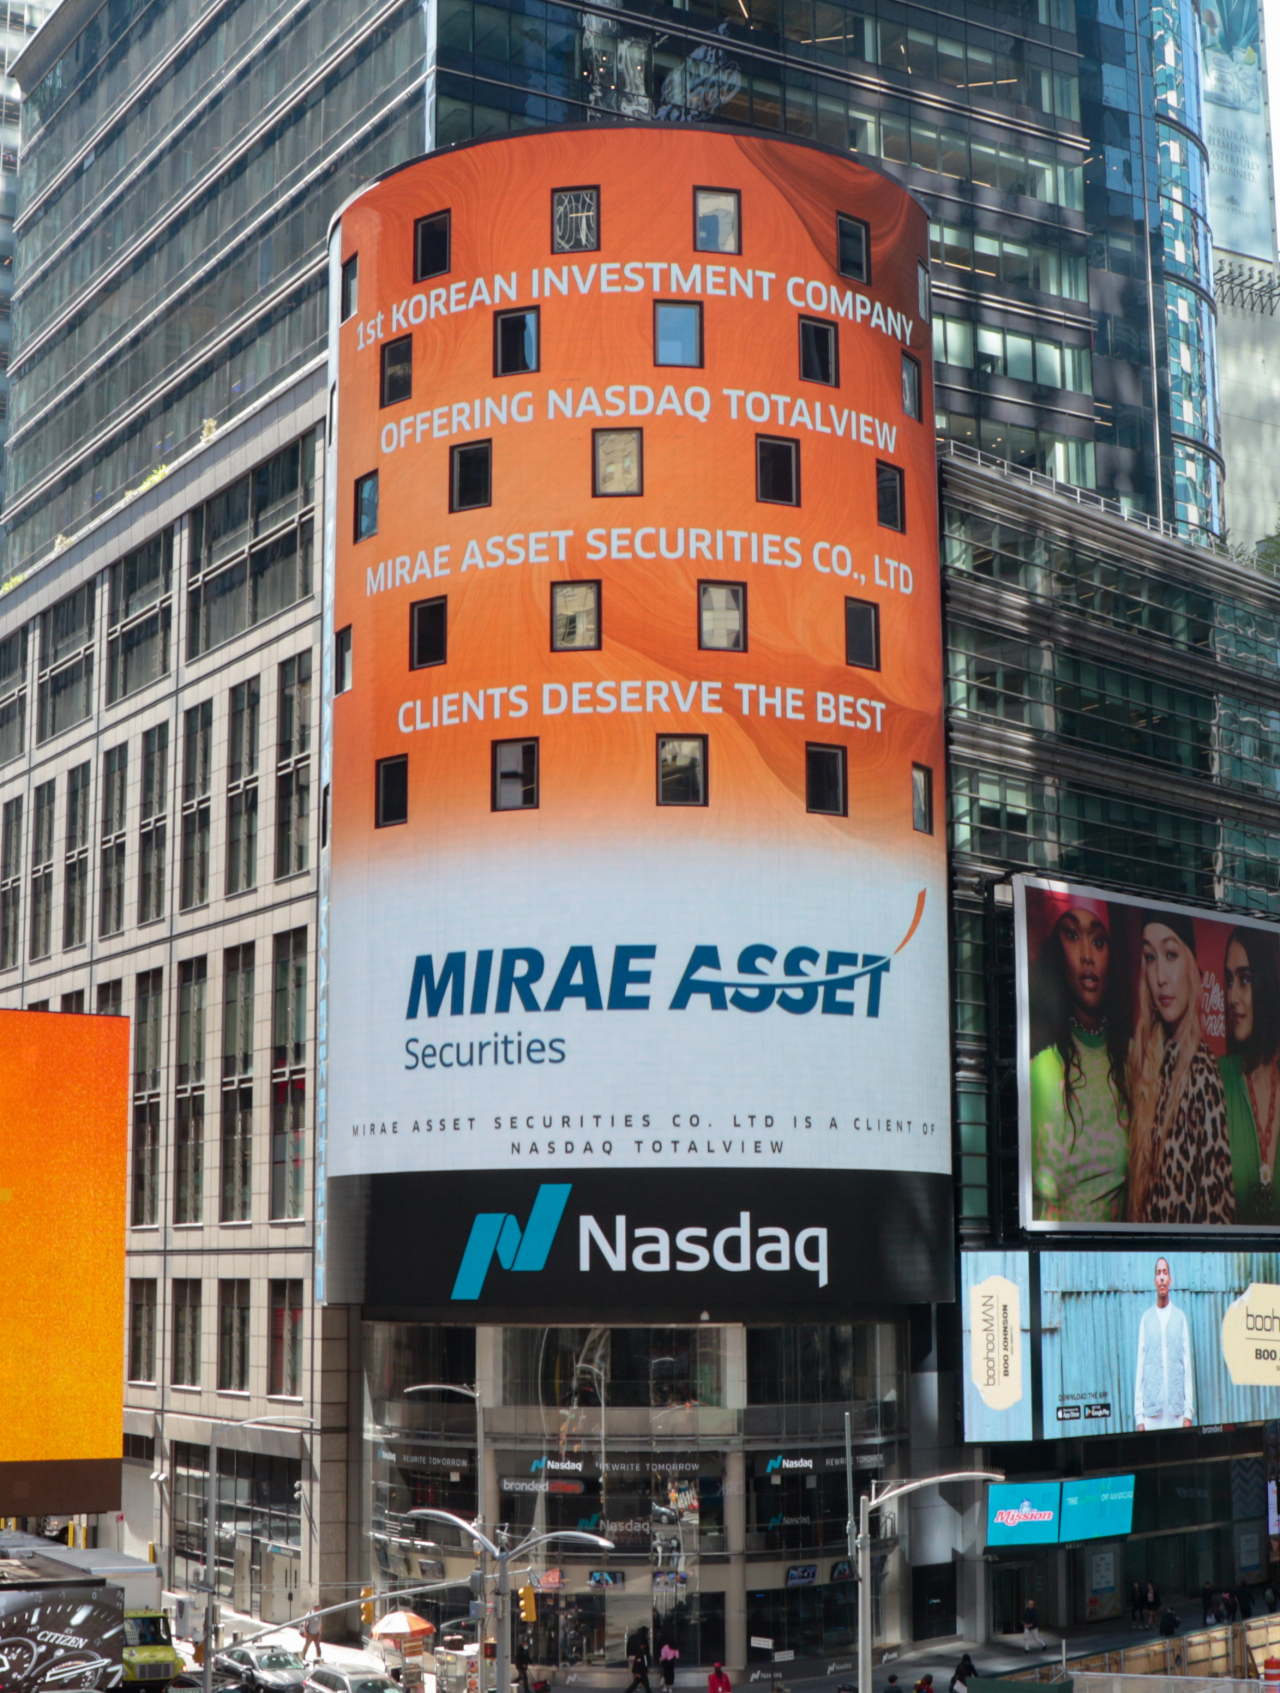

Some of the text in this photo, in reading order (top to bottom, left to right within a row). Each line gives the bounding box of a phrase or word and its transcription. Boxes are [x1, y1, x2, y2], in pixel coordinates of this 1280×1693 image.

[1208, 124, 1248, 144] NATURAL
[1208, 136, 1252, 156] ELEMENTS
[1209, 150, 1260, 172] ASTERFULLY
[356, 261, 914, 352] 1st KOREAN INVESTMENT COMPANY
[380, 384, 897, 454] OFFERING NASDAQ TOTALVIEW
[365, 527, 914, 598] MIRAE ASSET SECURITIES CO., LTD
[397, 680, 886, 734] CLIENTS DESERVE THE BEST
[405, 943, 892, 1021] MIRAE ASSET
[404, 1031, 566, 1071] Securities
[352, 1113, 935, 1137] MIRAE ASSET SECURITIES CO. LTD IS A CLIENT OF
[511, 1139, 785, 1155] NASDAQ TOTALVIEW
[579, 1211, 829, 1288] Nasdaq
[981, 1295, 995, 1387] boohooMAN
[1255, 1348, 1277, 1361] BOO
[547, 1460, 583, 1472] Nasdaq
[600, 1462, 700, 1472] REWRITE TOMORROW
[782, 1458, 813, 1470] Nasdaq
[826, 1457, 854, 1466] REWRIE
[600, 1520, 650, 1534] Nasdaq
[994, 1510, 1053, 1526] Mission
[36, 1630, 88, 1649] CITIZEN
[760, 1671, 782, 1679] Nasaq
